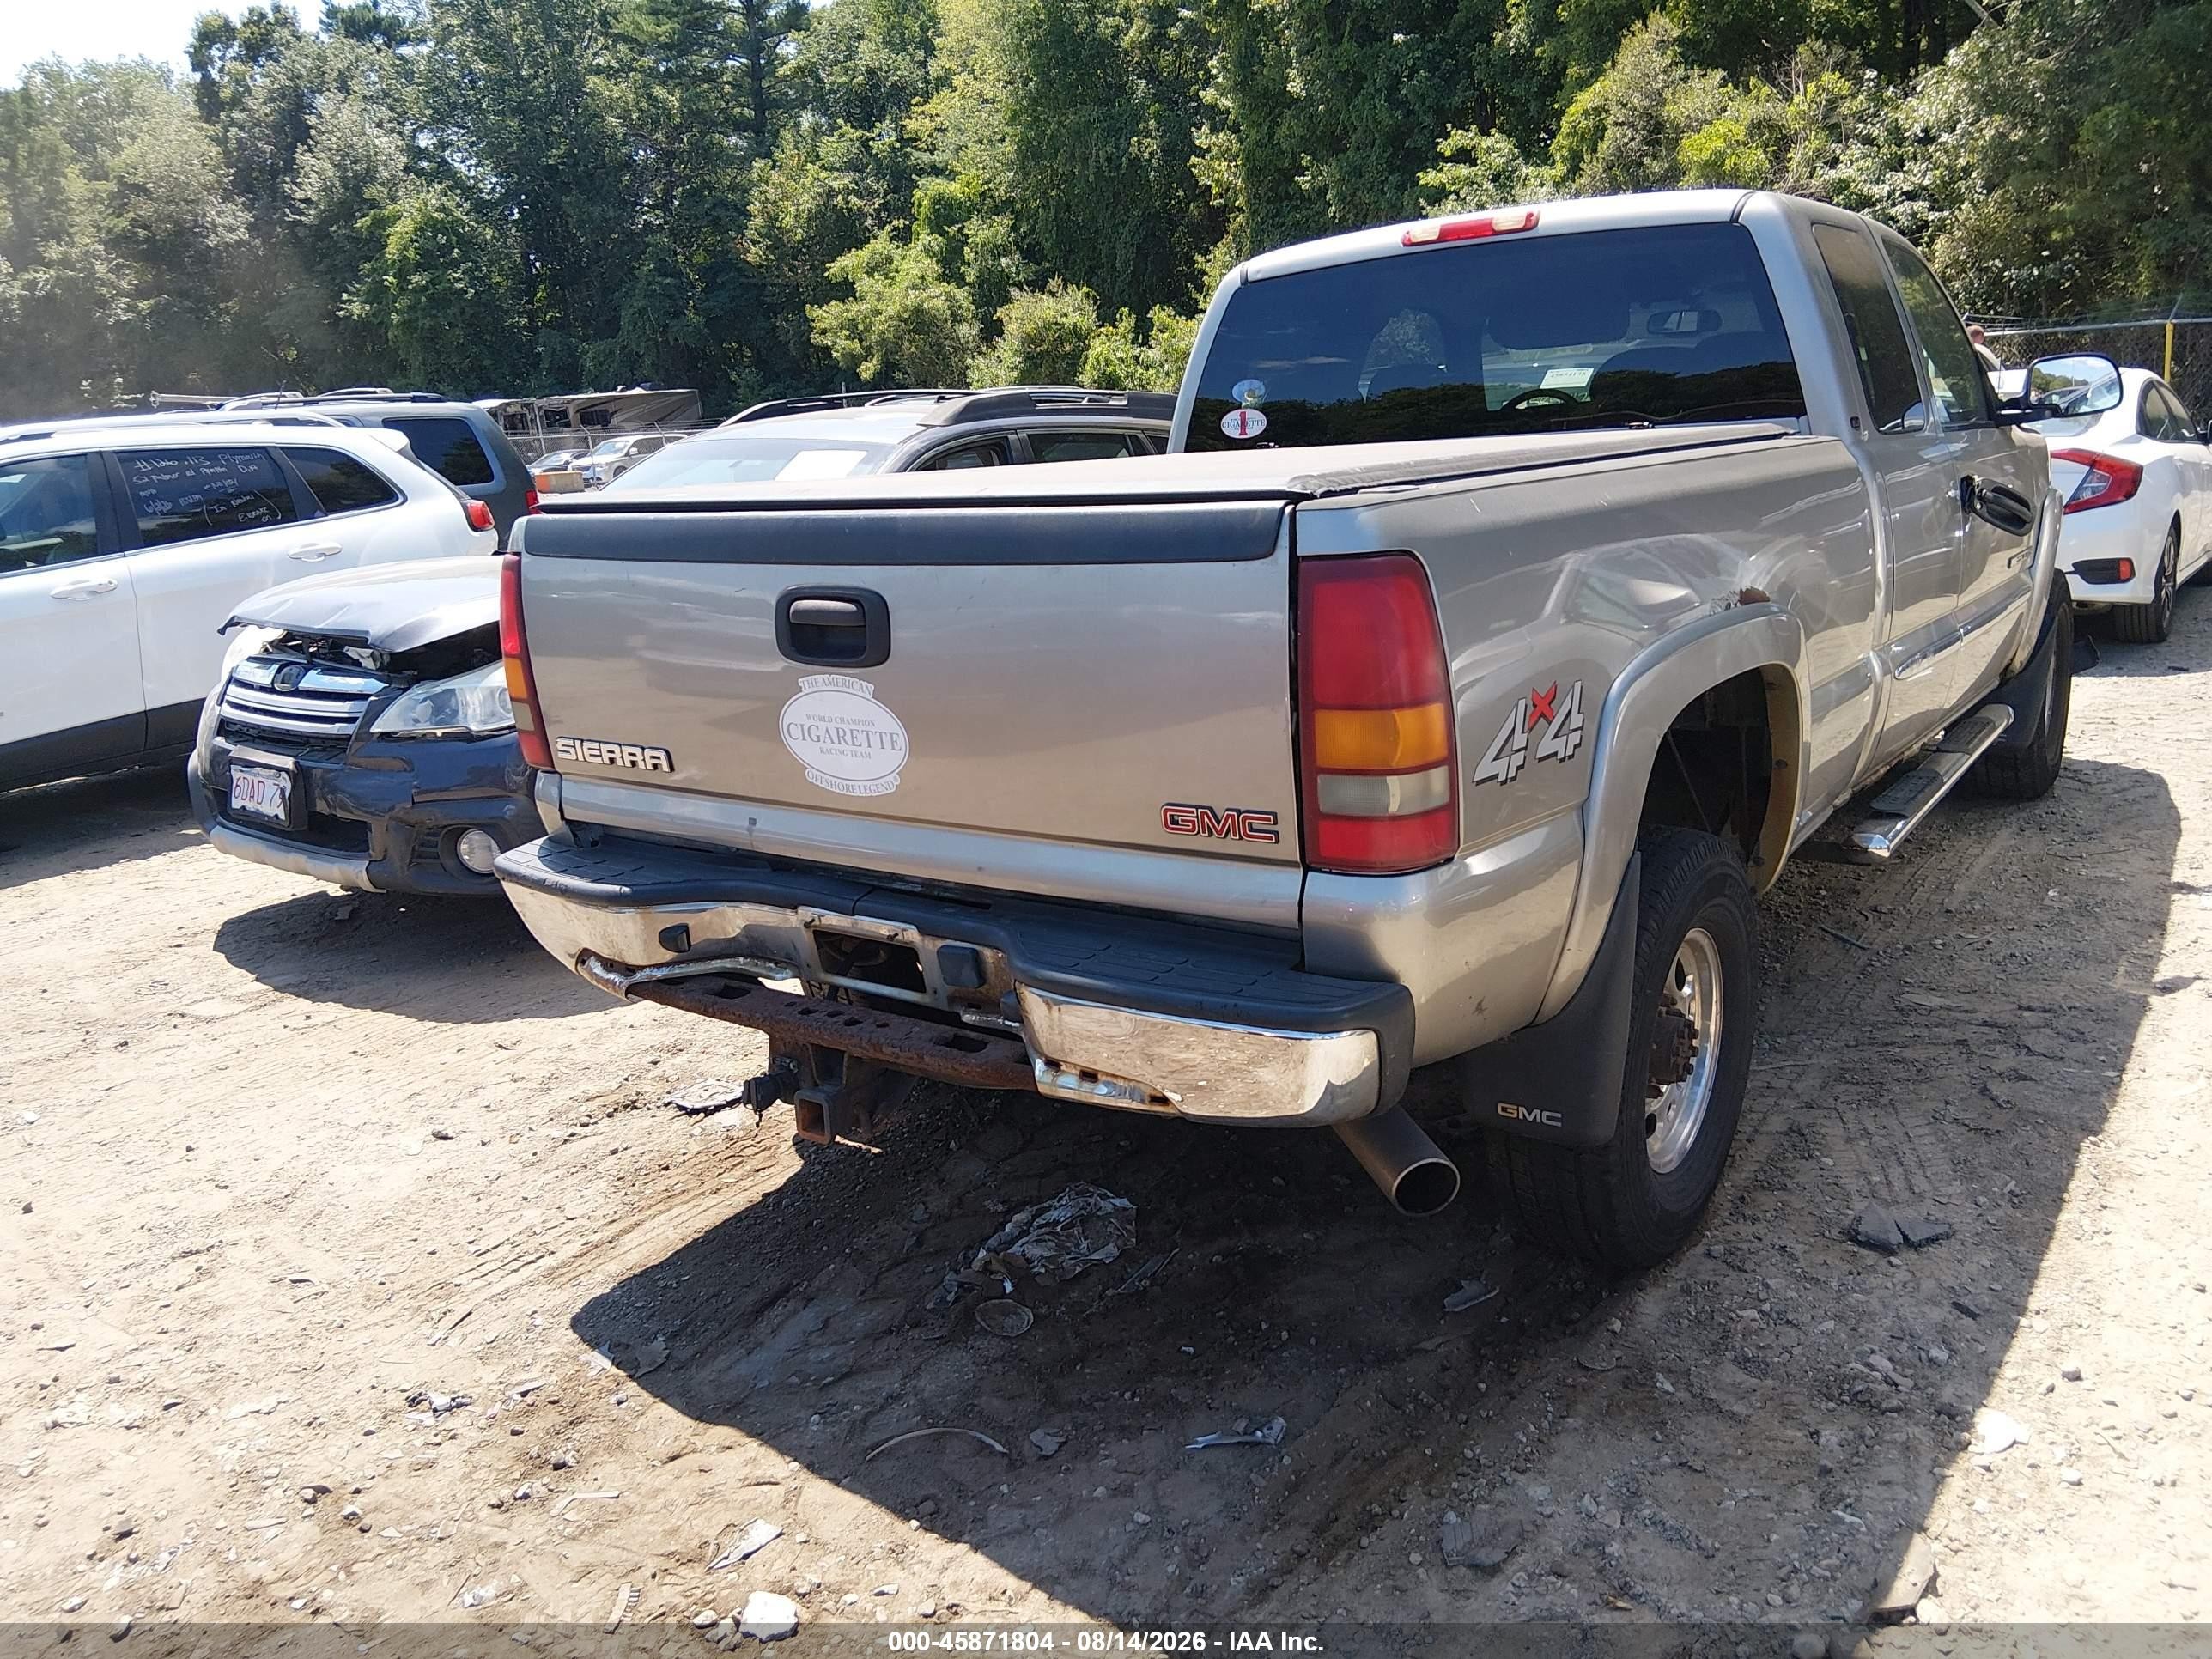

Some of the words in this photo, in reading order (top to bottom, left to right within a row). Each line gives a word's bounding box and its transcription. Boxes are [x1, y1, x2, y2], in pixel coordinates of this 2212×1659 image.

[1222, 417, 1266, 428] CIGAETTE
[799, 677, 820, 690] THE
[819, 677, 873, 696] AMERICAN
[805, 714, 833, 724] WORLD
[834, 716, 876, 727] CHAMPION
[787, 722, 902, 751] CIGARETTE
[556, 736, 675, 773] SIERRA
[819, 746, 848, 757] RACING
[850, 749, 872, 760] TEAM
[807, 770, 858, 794] OFFSHORE
[1161, 802, 1279, 844] GMC
[1497, 1103, 1562, 1127] GMC
